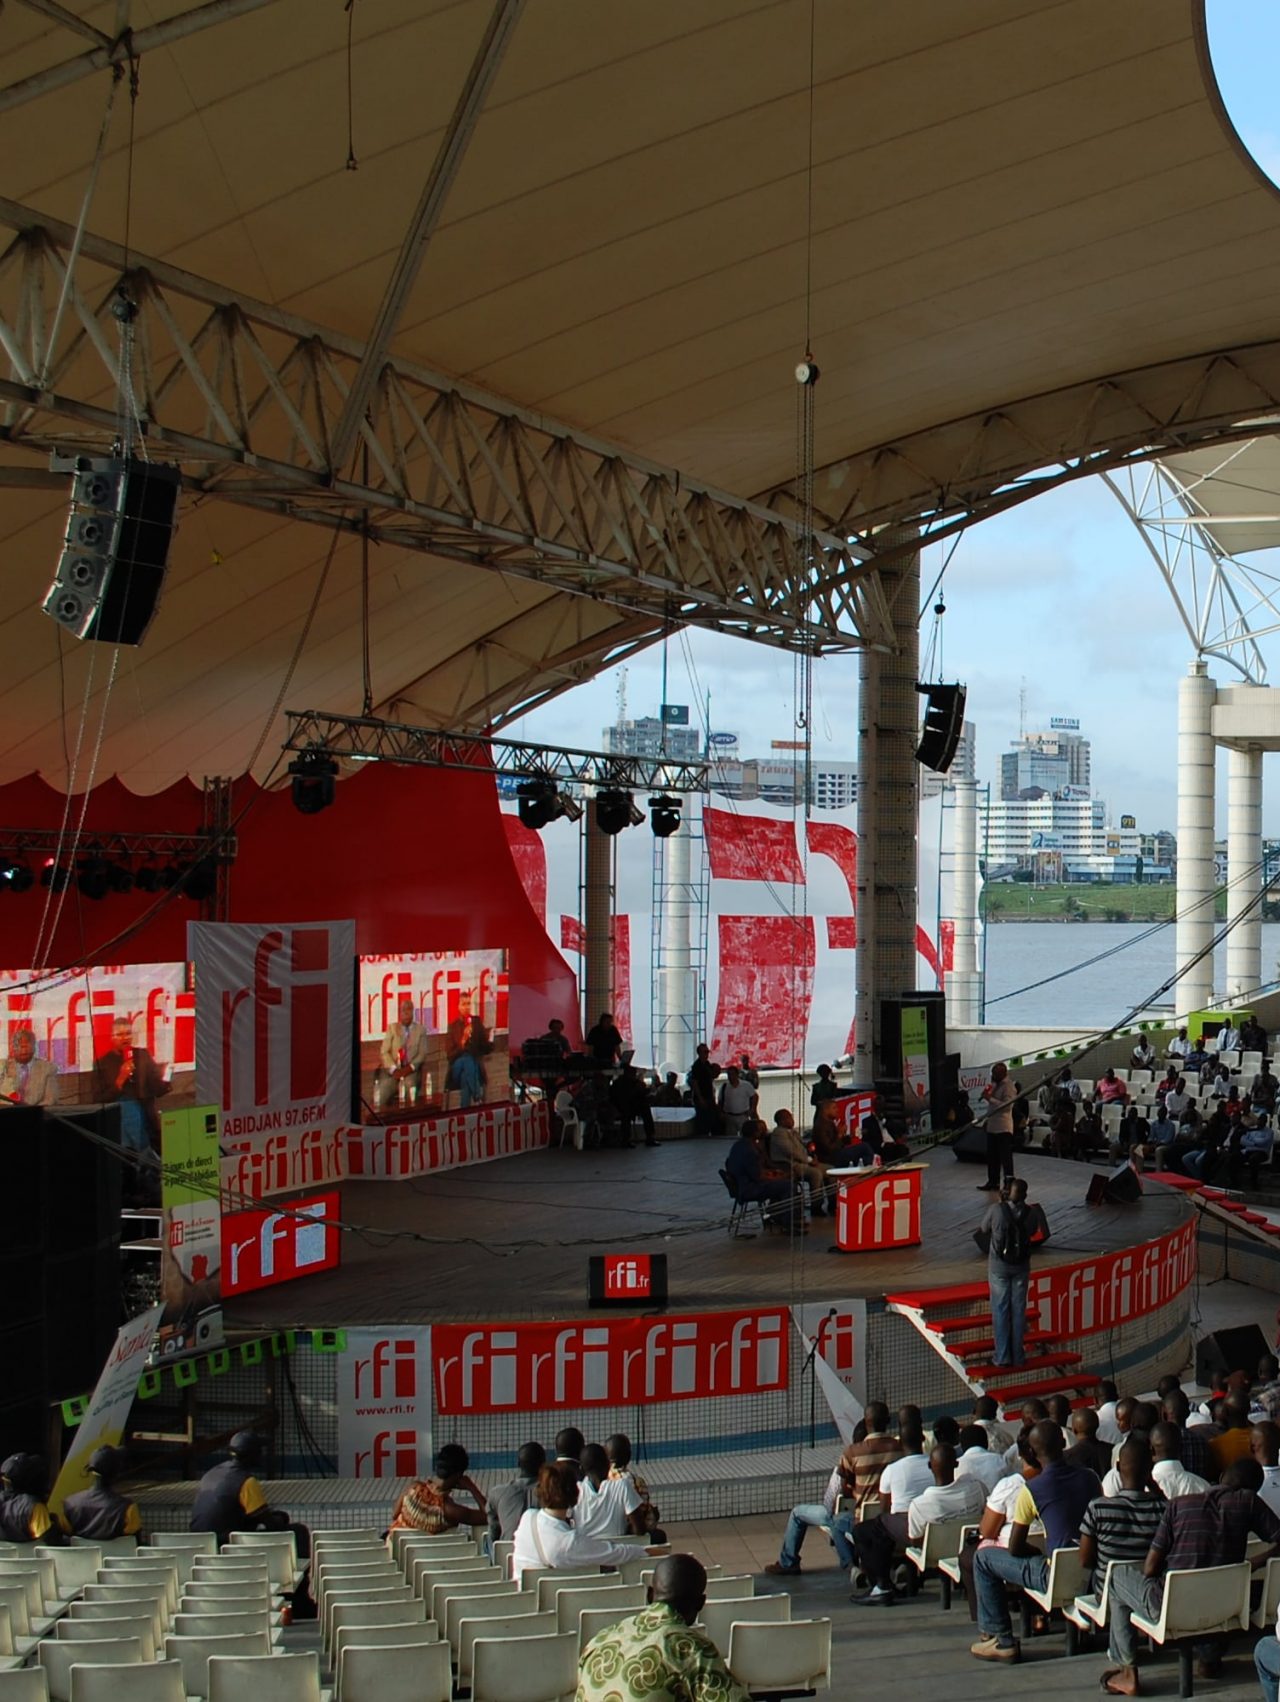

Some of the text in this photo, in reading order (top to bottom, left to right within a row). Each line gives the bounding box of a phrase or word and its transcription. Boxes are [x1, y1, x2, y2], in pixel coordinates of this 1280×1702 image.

[47, 990, 115, 1067] rfi
[222, 929, 328, 1111] rfi
[368, 971, 412, 1034] rfi
[420, 970, 460, 1029] rfi
[223, 1104, 326, 1137] ABIDJAN 97.6FM
[292, 1130, 322, 1185] rfi
[326, 1127, 363, 1178] rfi
[372, 1126, 409, 1175] rfi
[411, 1120, 439, 1172] rfi
[442, 1114, 467, 1166] rfi
[471, 1110, 494, 1158] rfi
[498, 1105, 521, 1154] rfi
[525, 1101, 549, 1148] rfi
[231, 1202, 326, 1285] rfi
[858, 1179, 910, 1244] rfi
[608, 1262, 650, 1289] rfi.fr
[1058, 1267, 1096, 1334] rfi
[1100, 1256, 1132, 1325] rfi
[1135, 1246, 1159, 1313] rfi
[1161, 1236, 1179, 1300] rfi
[355, 1340, 415, 1399] rfi
[439, 1315, 781, 1408] rfi rfi rfi rfi
[355, 1404, 415, 1416] www.rfi.fr
[355, 1430, 417, 1478] rfi
